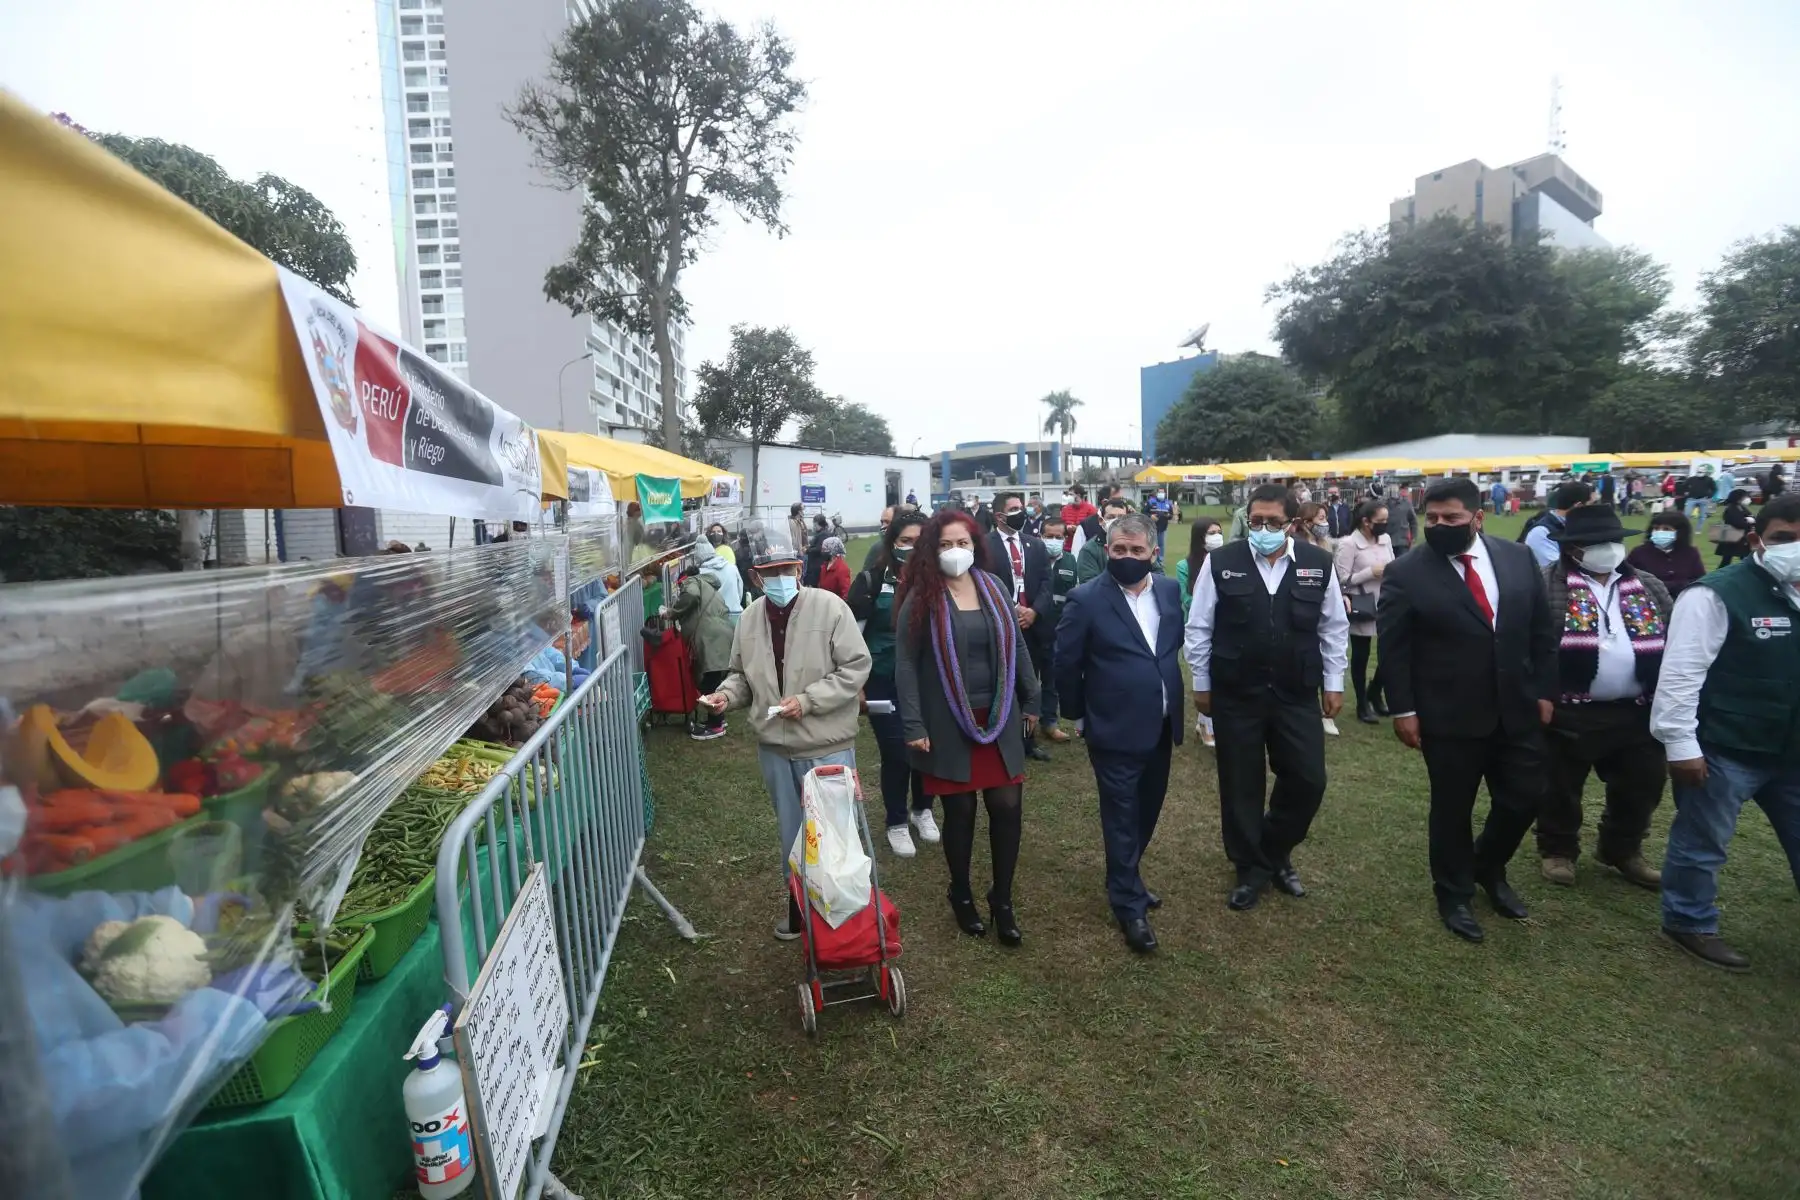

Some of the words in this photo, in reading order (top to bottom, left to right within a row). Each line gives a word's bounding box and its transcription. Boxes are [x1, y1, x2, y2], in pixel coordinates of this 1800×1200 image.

[360, 380, 402, 421] PERÚ
[415, 402, 430, 427] de
[410, 438, 417, 461] y
[418, 436, 445, 466] Riego
